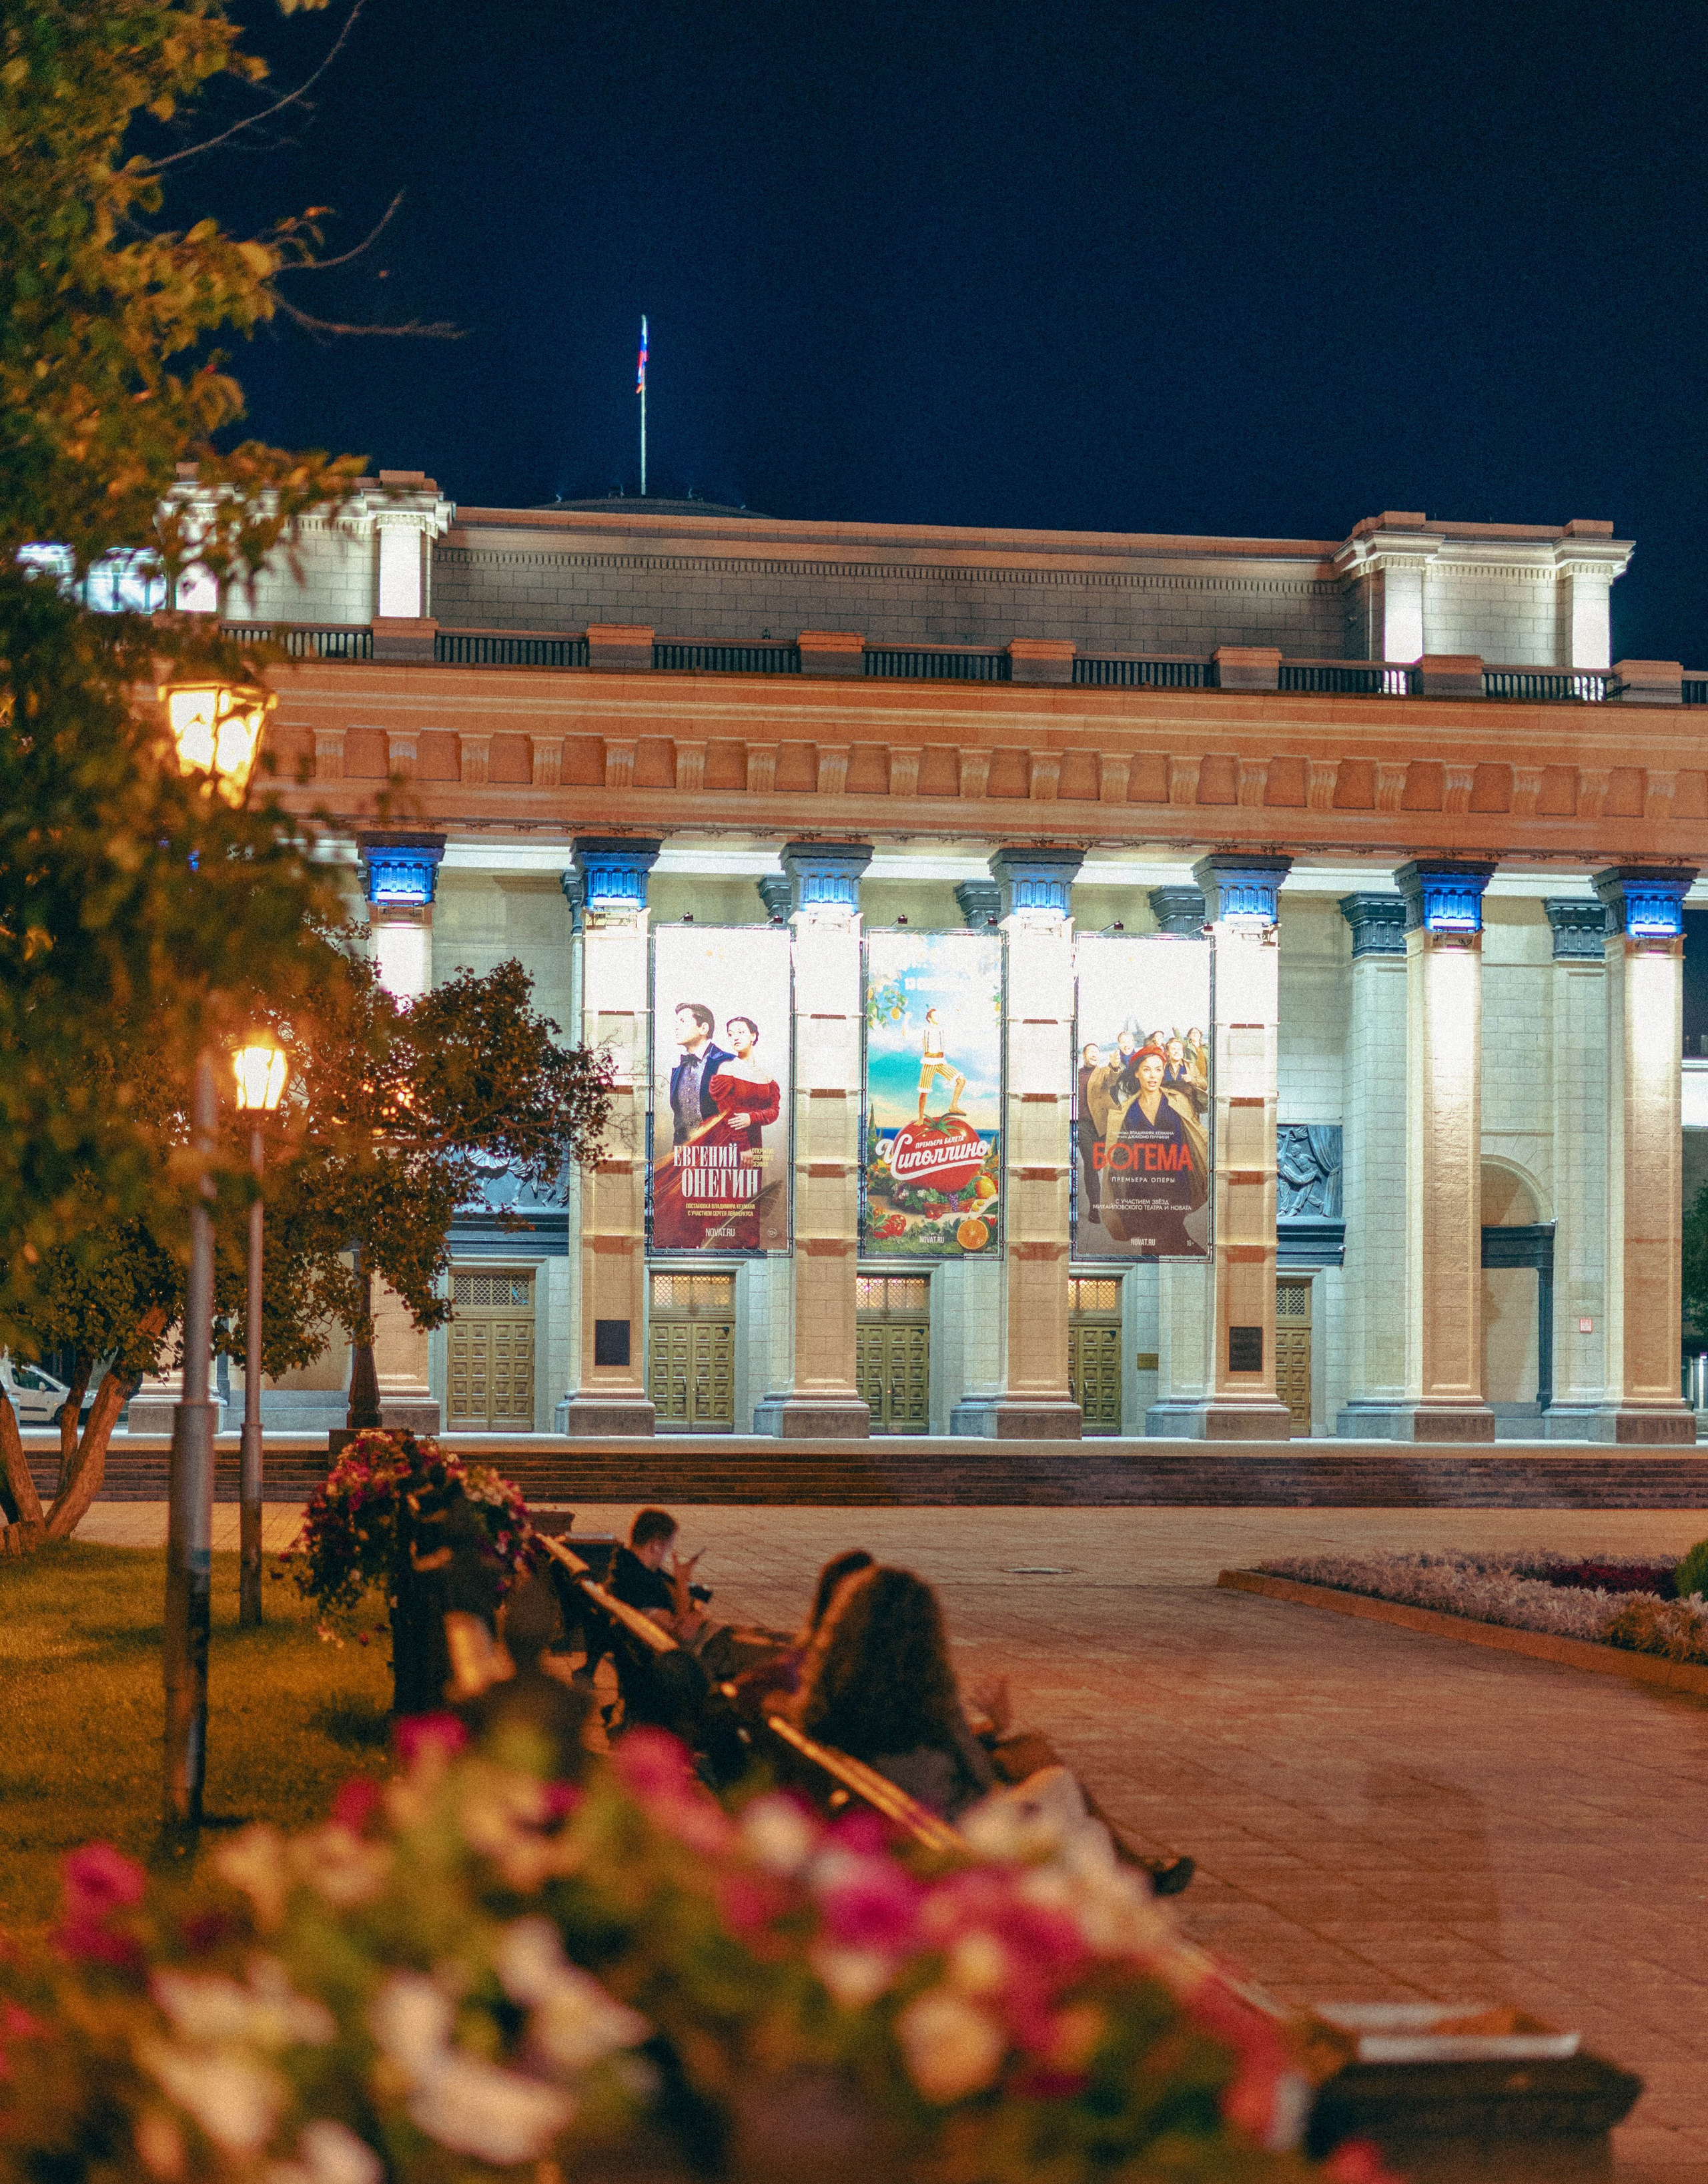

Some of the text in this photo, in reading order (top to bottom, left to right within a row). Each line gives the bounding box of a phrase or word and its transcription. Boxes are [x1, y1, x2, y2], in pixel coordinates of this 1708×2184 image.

[915, 1135, 965, 1149] ПРЕМЬЕРА БАЛЕТА
[673, 1143, 738, 1168] ЕВГЕНИЙ
[875, 1134, 990, 1180] Чиполлино
[1092, 1142, 1193, 1171] БОГЕМА
[682, 1168, 759, 1198] ОНЕГИН
[705, 1228, 735, 1237] NOVAT.RU
[919, 1236, 945, 1244] NOVAT.RU
[1130, 1238, 1156, 1246] NOVAT.RU
